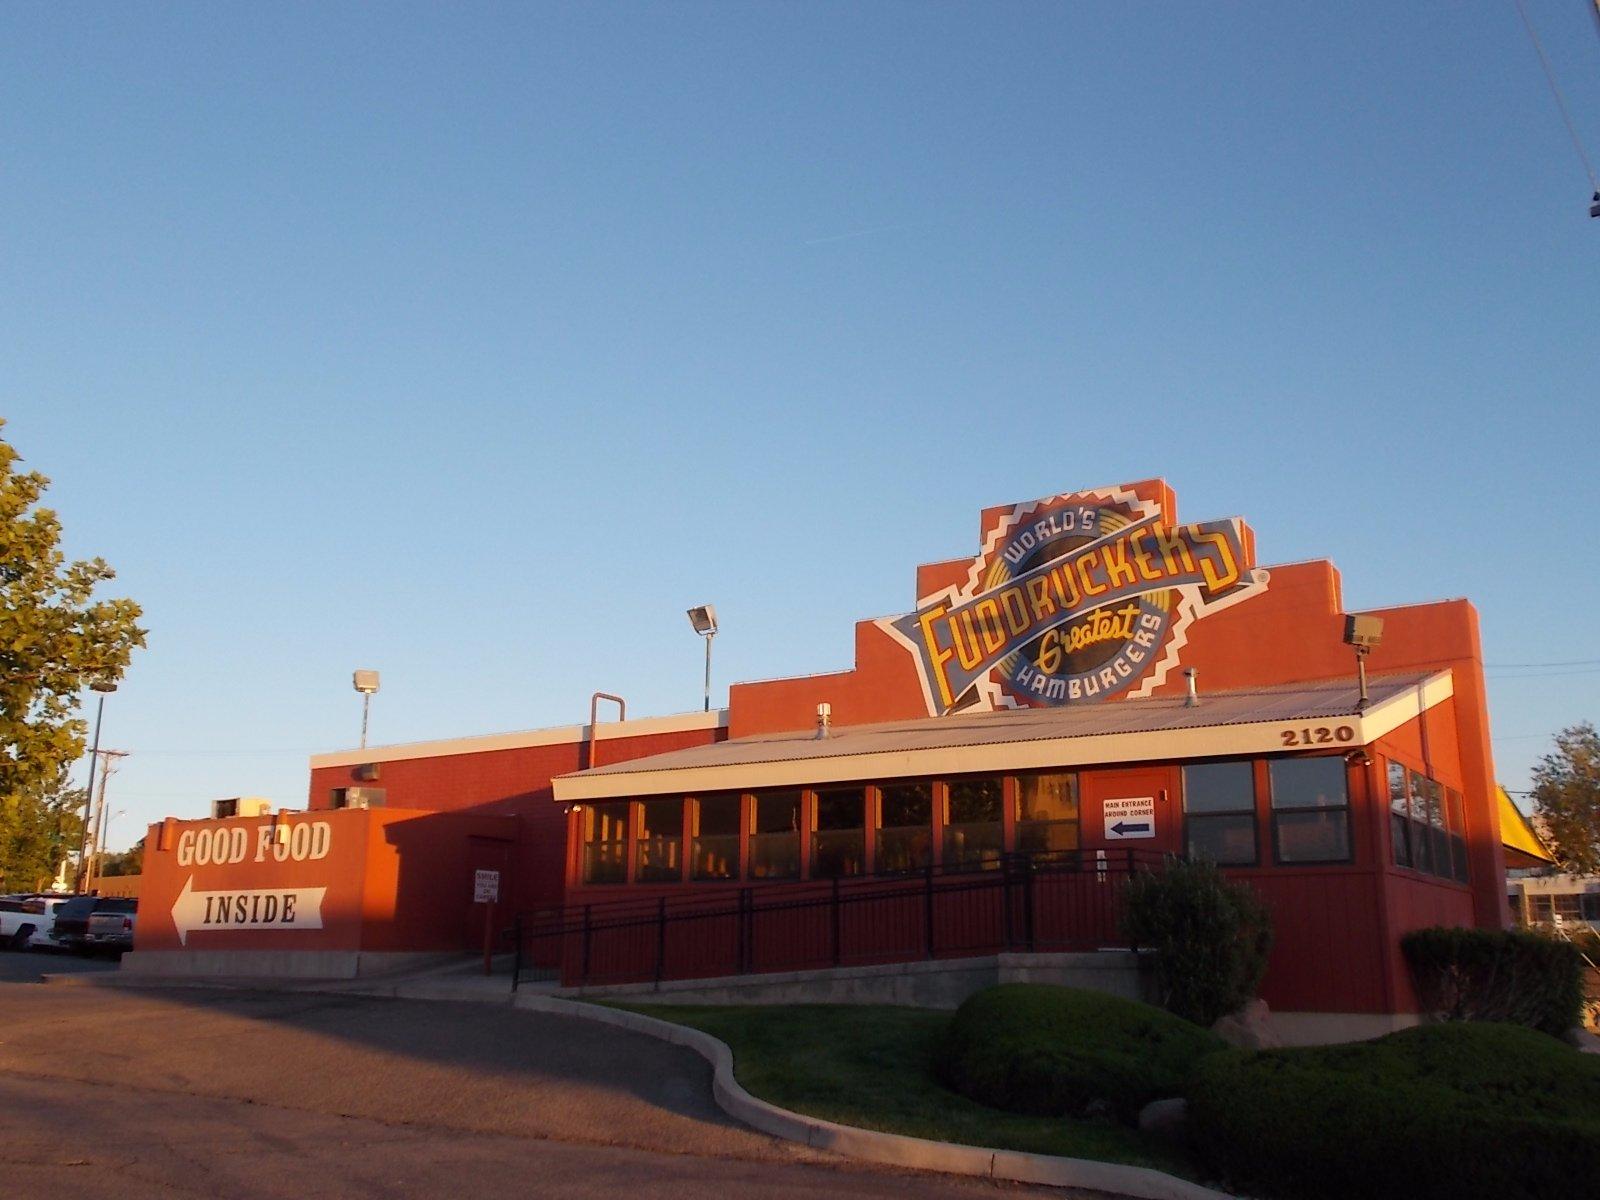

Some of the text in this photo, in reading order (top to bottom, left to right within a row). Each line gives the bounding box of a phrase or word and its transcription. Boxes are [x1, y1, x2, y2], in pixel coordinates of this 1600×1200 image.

[1004, 507, 1096, 564] WORLD'S
[919, 520, 1238, 708] FUDDRUCKERS
[1016, 613, 1162, 700] HAMBURGERS
[1033, 603, 1142, 675] Greatest
[1280, 725, 1355, 747] 2120
[1104, 809, 1154, 818] AROUND CORNER
[1121, 799, 1152, 808] ENTRANCE
[177, 821, 332, 867] GOOD FOOD
[203, 894, 297, 925] INSIDE
